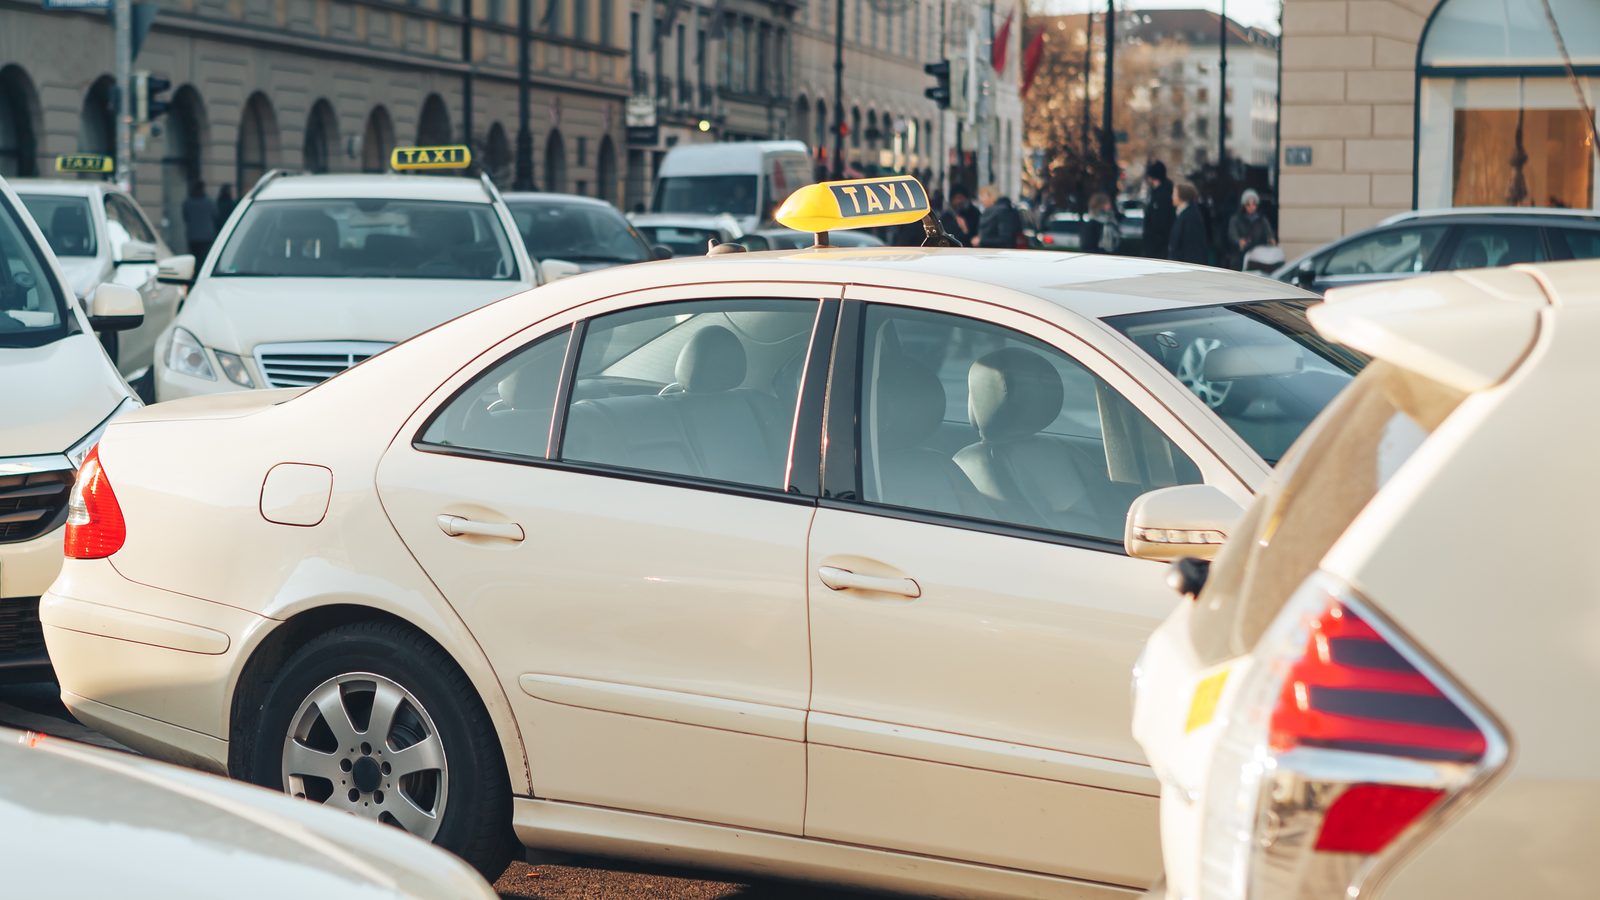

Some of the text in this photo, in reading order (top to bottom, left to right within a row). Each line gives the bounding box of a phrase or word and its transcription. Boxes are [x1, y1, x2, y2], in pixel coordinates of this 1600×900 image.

[66, 157, 101, 169] TAXI
[404, 150, 456, 163] TAXI
[842, 182, 916, 213] TAXI
